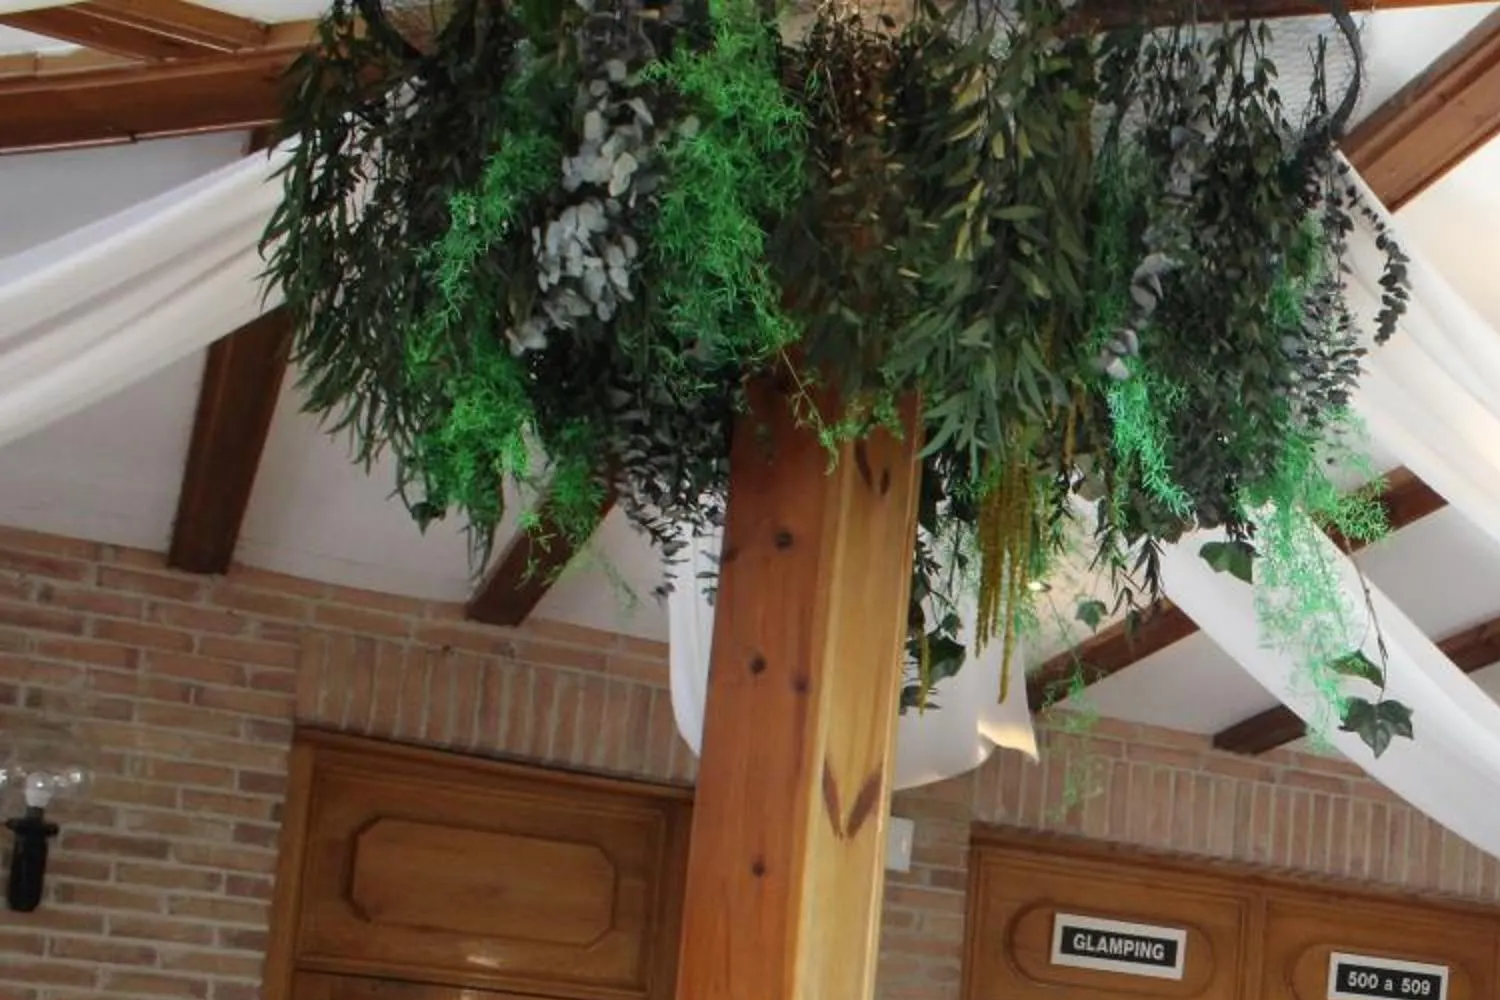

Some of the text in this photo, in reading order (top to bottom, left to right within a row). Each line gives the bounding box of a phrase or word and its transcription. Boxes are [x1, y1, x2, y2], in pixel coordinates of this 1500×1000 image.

[1073, 933, 1165, 960] GLAMPING
[1347, 971, 1431, 996] 500 a 509
